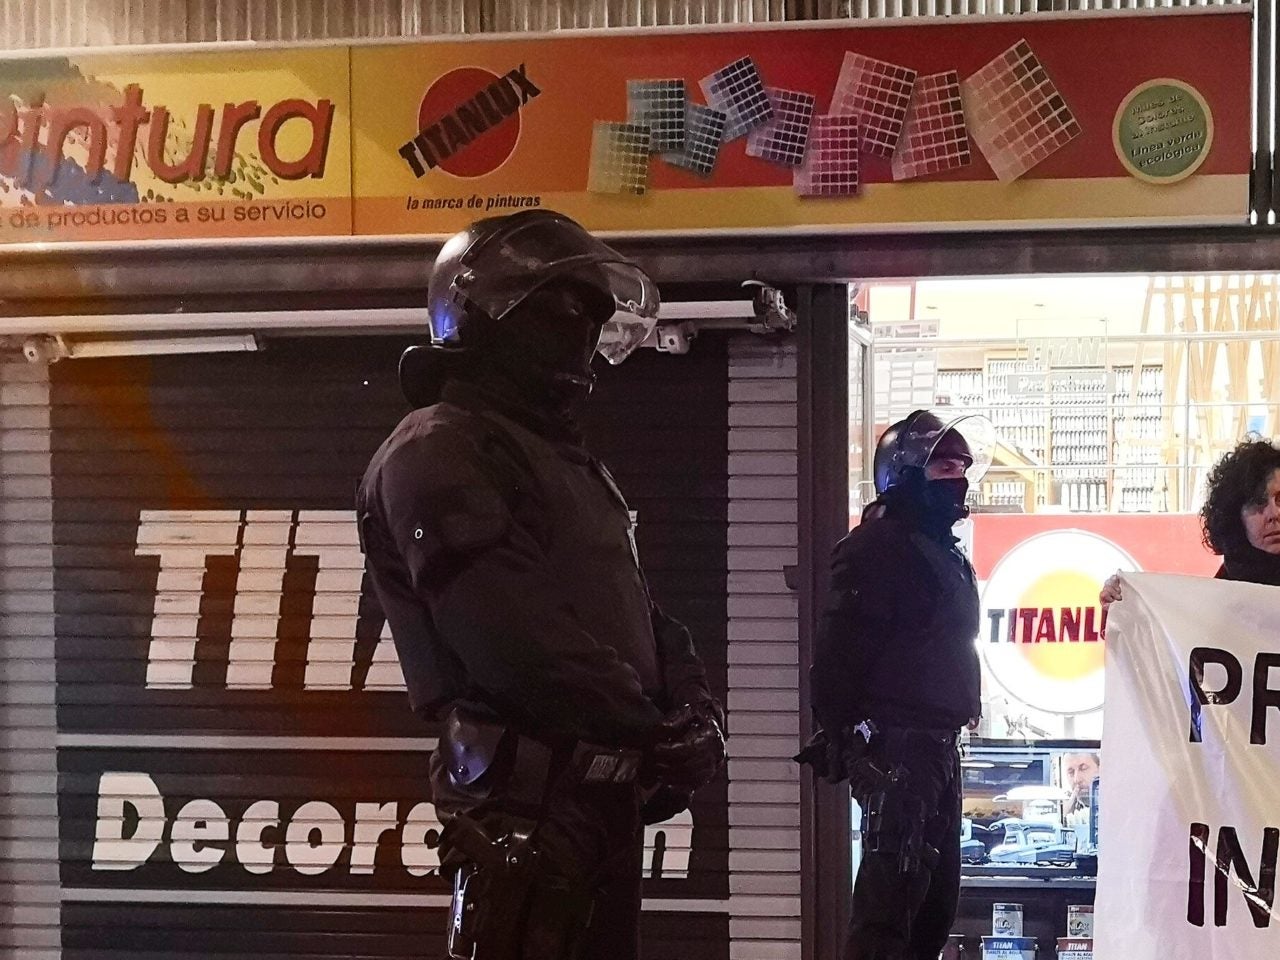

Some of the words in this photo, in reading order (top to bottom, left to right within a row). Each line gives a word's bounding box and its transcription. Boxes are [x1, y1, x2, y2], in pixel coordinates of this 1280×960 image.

[0, 82, 336, 187] intura
[398, 62, 542, 179] TITANLUX
[9, 207, 40, 229] de
[47, 205, 168, 230] productos
[175, 207, 190, 223] a
[197, 207, 226, 223] su
[233, 200, 327, 221] servicio
[406, 196, 419, 211] la
[422, 197, 463, 210] marca
[467, 195, 484, 209] de
[485, 194, 541, 211] pinturas
